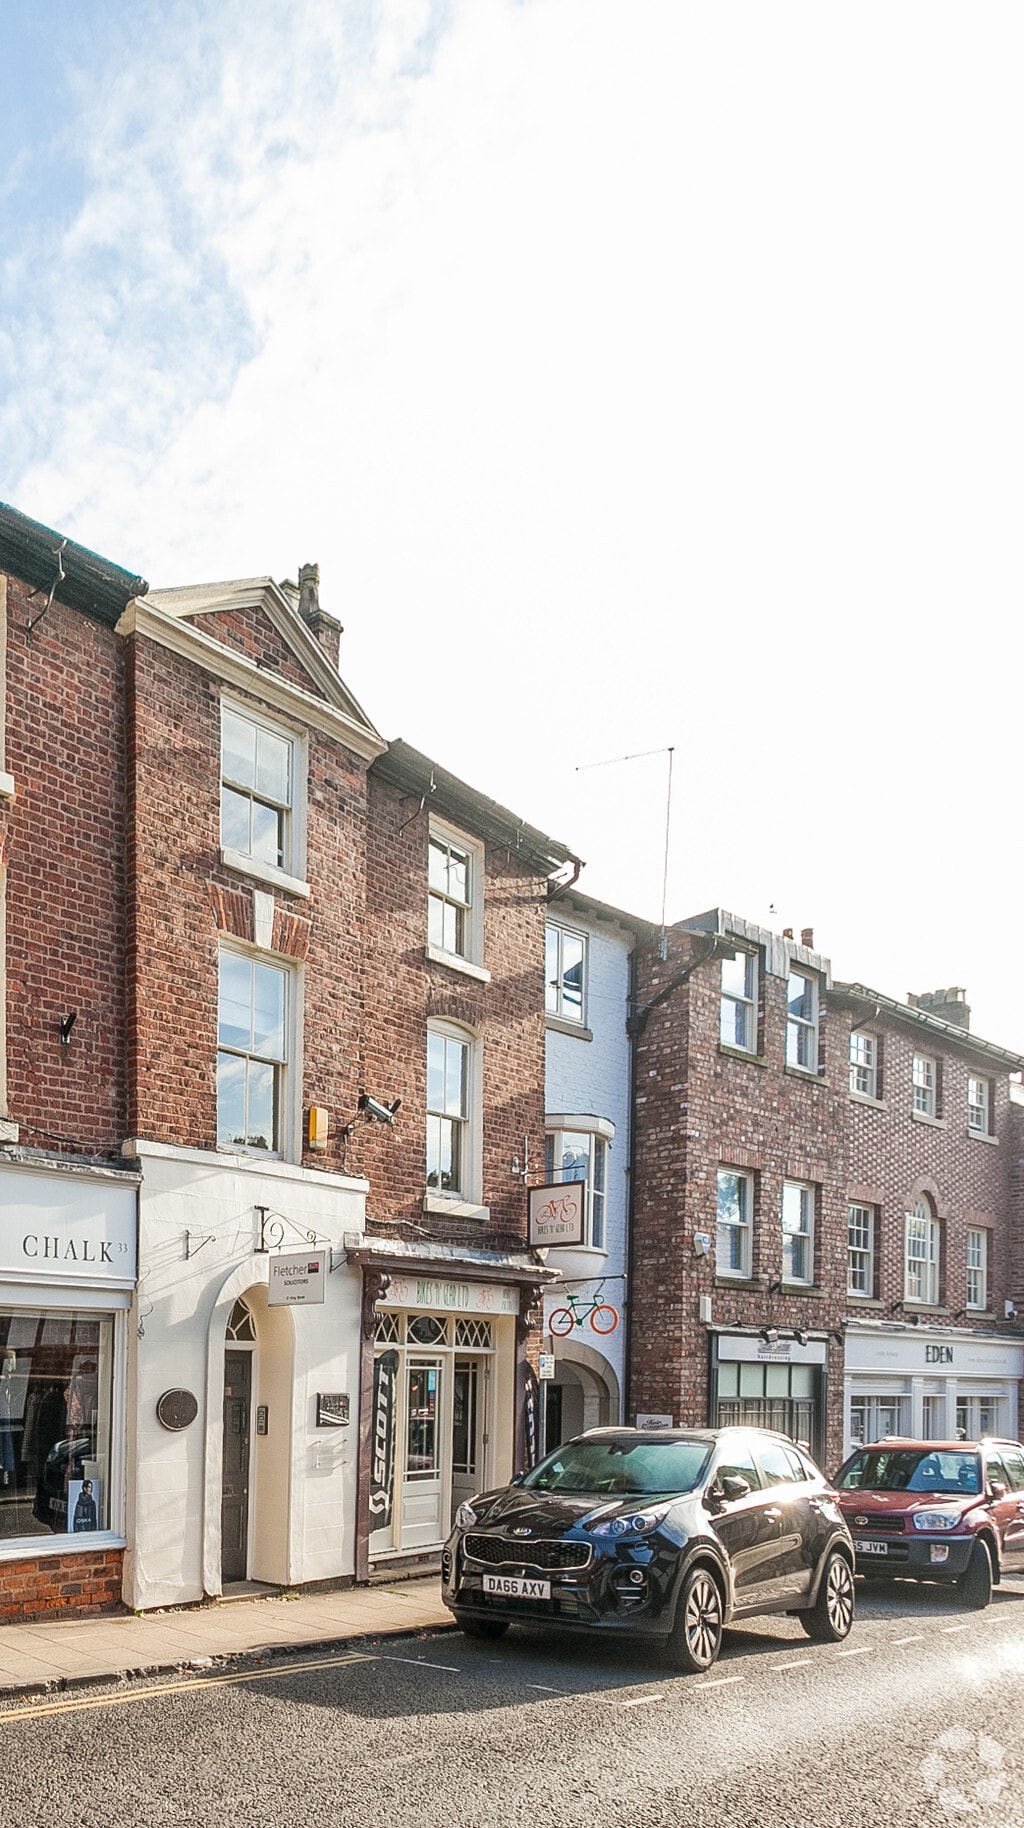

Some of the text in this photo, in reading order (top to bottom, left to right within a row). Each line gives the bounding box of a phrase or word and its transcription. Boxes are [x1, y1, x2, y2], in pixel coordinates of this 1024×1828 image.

[22, 1234, 128, 1263] CHALK 33
[273, 1263, 307, 1277] Fletcher
[416, 1280, 433, 1305] BIKES
[457, 1284, 470, 1308] LTD
[925, 1345, 954, 1364] EDEN
[374, 1363, 389, 1487] SCOTT
[488, 1578, 545, 1597] DA66 AXV
